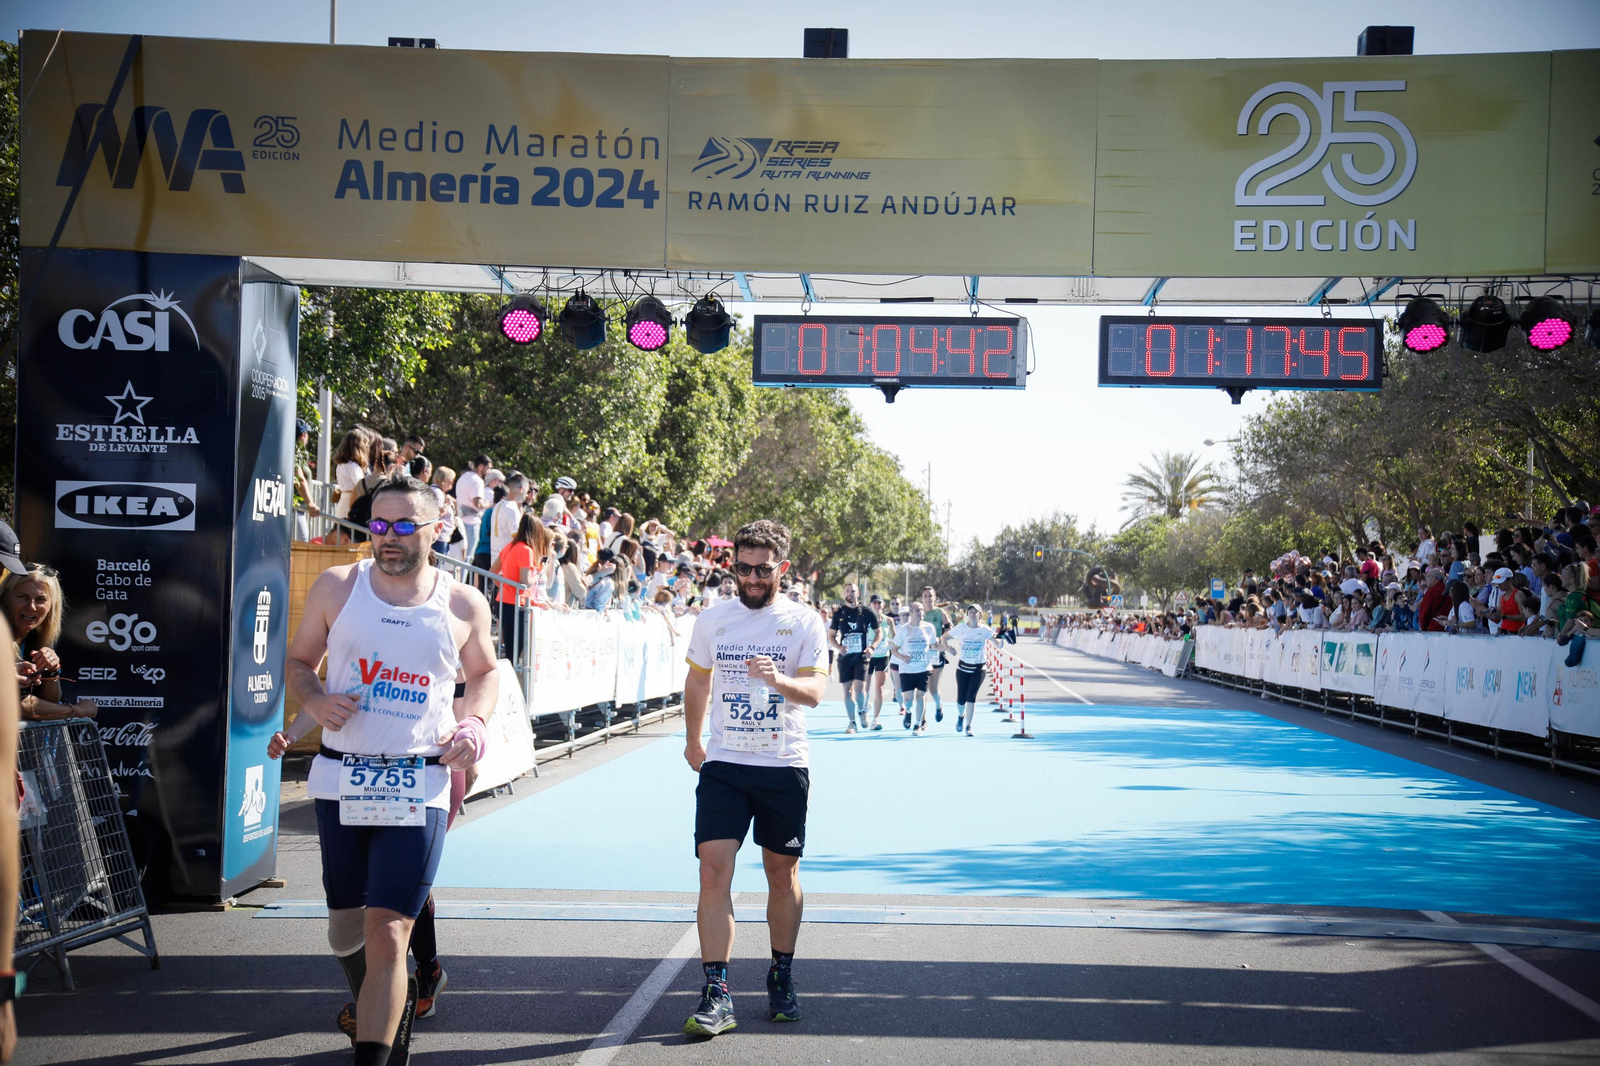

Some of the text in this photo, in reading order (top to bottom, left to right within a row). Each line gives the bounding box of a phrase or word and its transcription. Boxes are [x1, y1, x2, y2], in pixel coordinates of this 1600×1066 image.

[253, 115, 300, 148] 25
[338, 118, 659, 160] Medio Maratón
[773, 140, 840, 155] RFEA
[1234, 80, 1418, 207] 25
[252, 149, 300, 161] EDICIÓN
[766, 157, 833, 168] SERIES
[334, 159, 660, 209] Almería 2024
[760, 170, 871, 181] RUTA RUNNING
[688, 188, 1016, 216] RAMÓN RUIZ ANDÚJAR
[1233, 211, 1417, 252] EDICIÓN
[58, 308, 169, 352] CASI
[798, 323, 1013, 378] 01:04:42
[1145, 324, 1369, 381] 01:17:45
[55, 424, 200, 444] ESTRELLA
[88, 443, 168, 453] DE LEVANTE
[75, 495, 180, 516] IKEA
[97, 558, 151, 572] Barceló
[96, 573, 152, 587] Cabo de
[96, 588, 128, 601] Gata
[86, 613, 157, 651] ego
[381, 617, 405, 627] CRAFT
[716, 644, 787, 652] Medio Maratón
[78, 667, 117, 680] SER
[142, 668, 166, 684] 40
[359, 658, 430, 687] Valero
[110, 698, 122, 706] de
[123, 698, 162, 706] Almería
[372, 681, 427, 704] Alonso
[79, 760, 156, 779] Analucía
[349, 767, 416, 789] 5755
